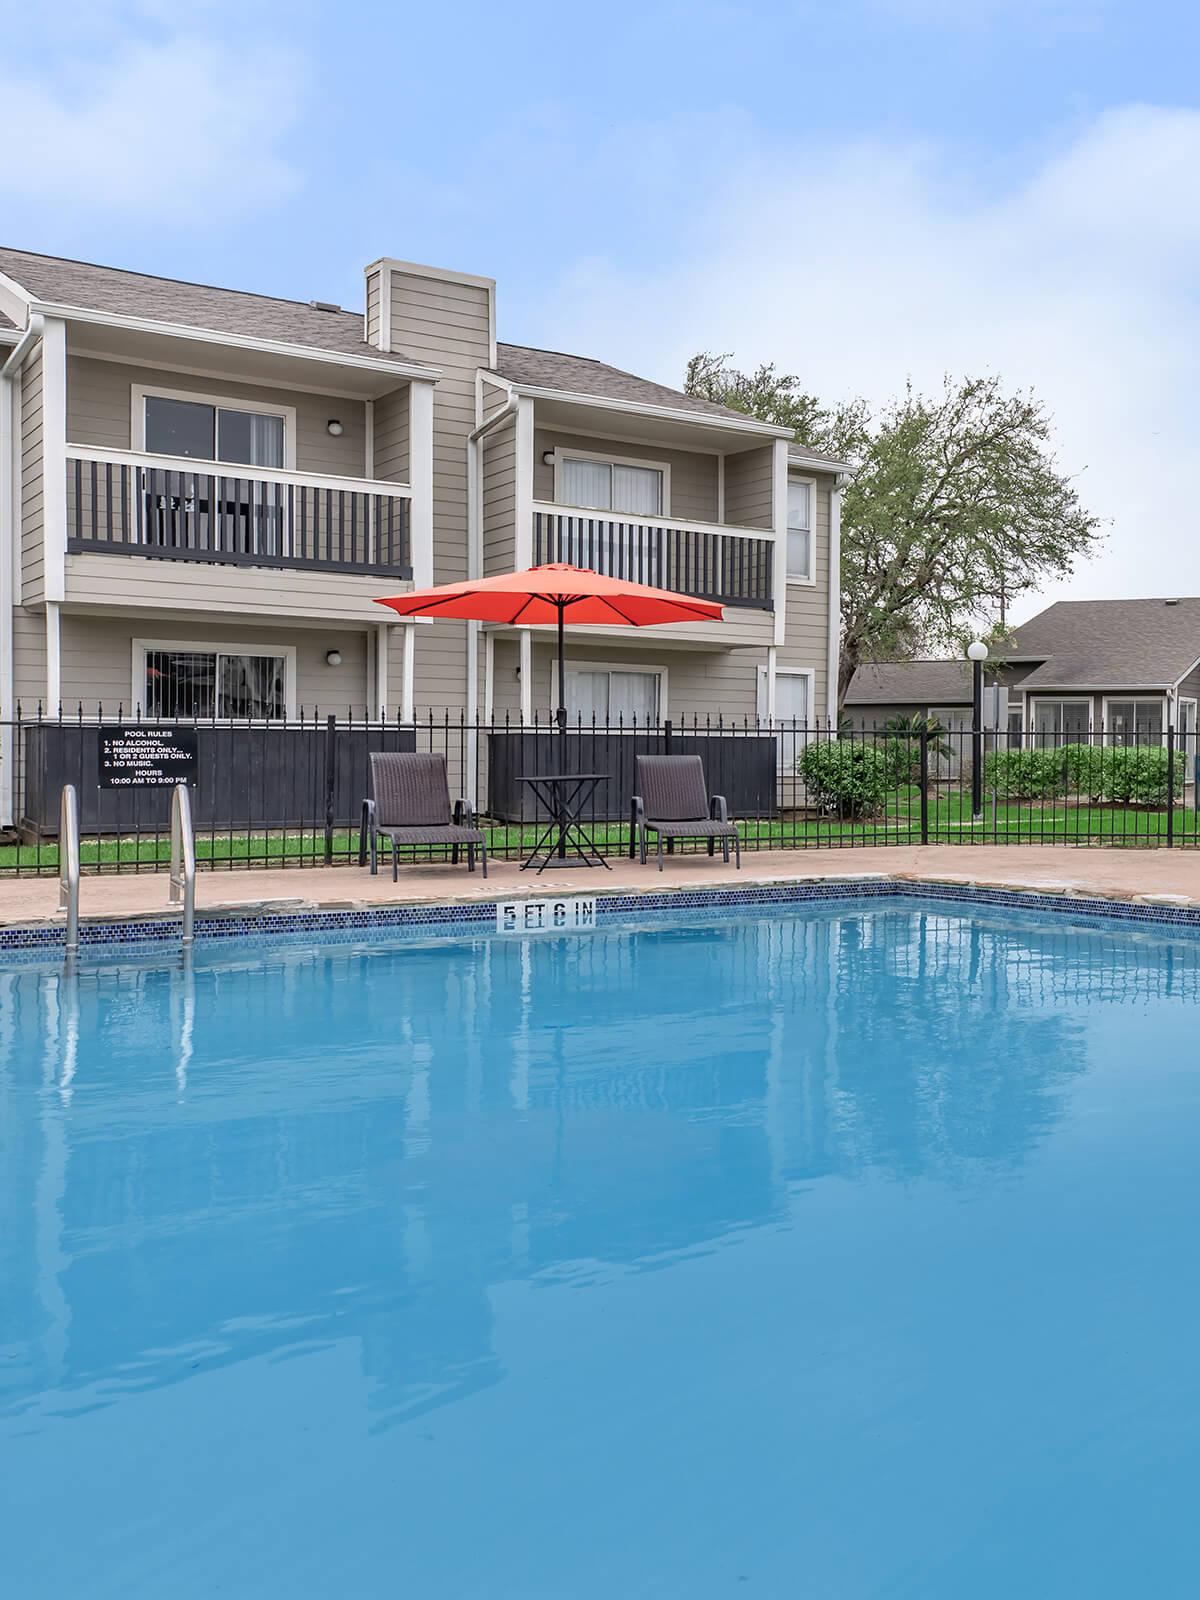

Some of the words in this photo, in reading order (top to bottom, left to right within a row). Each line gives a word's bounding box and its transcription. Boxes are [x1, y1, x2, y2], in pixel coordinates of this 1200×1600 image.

[503, 905, 516, 921] 5
[524, 903, 546, 921] FT
[575, 901, 593, 918] IN
